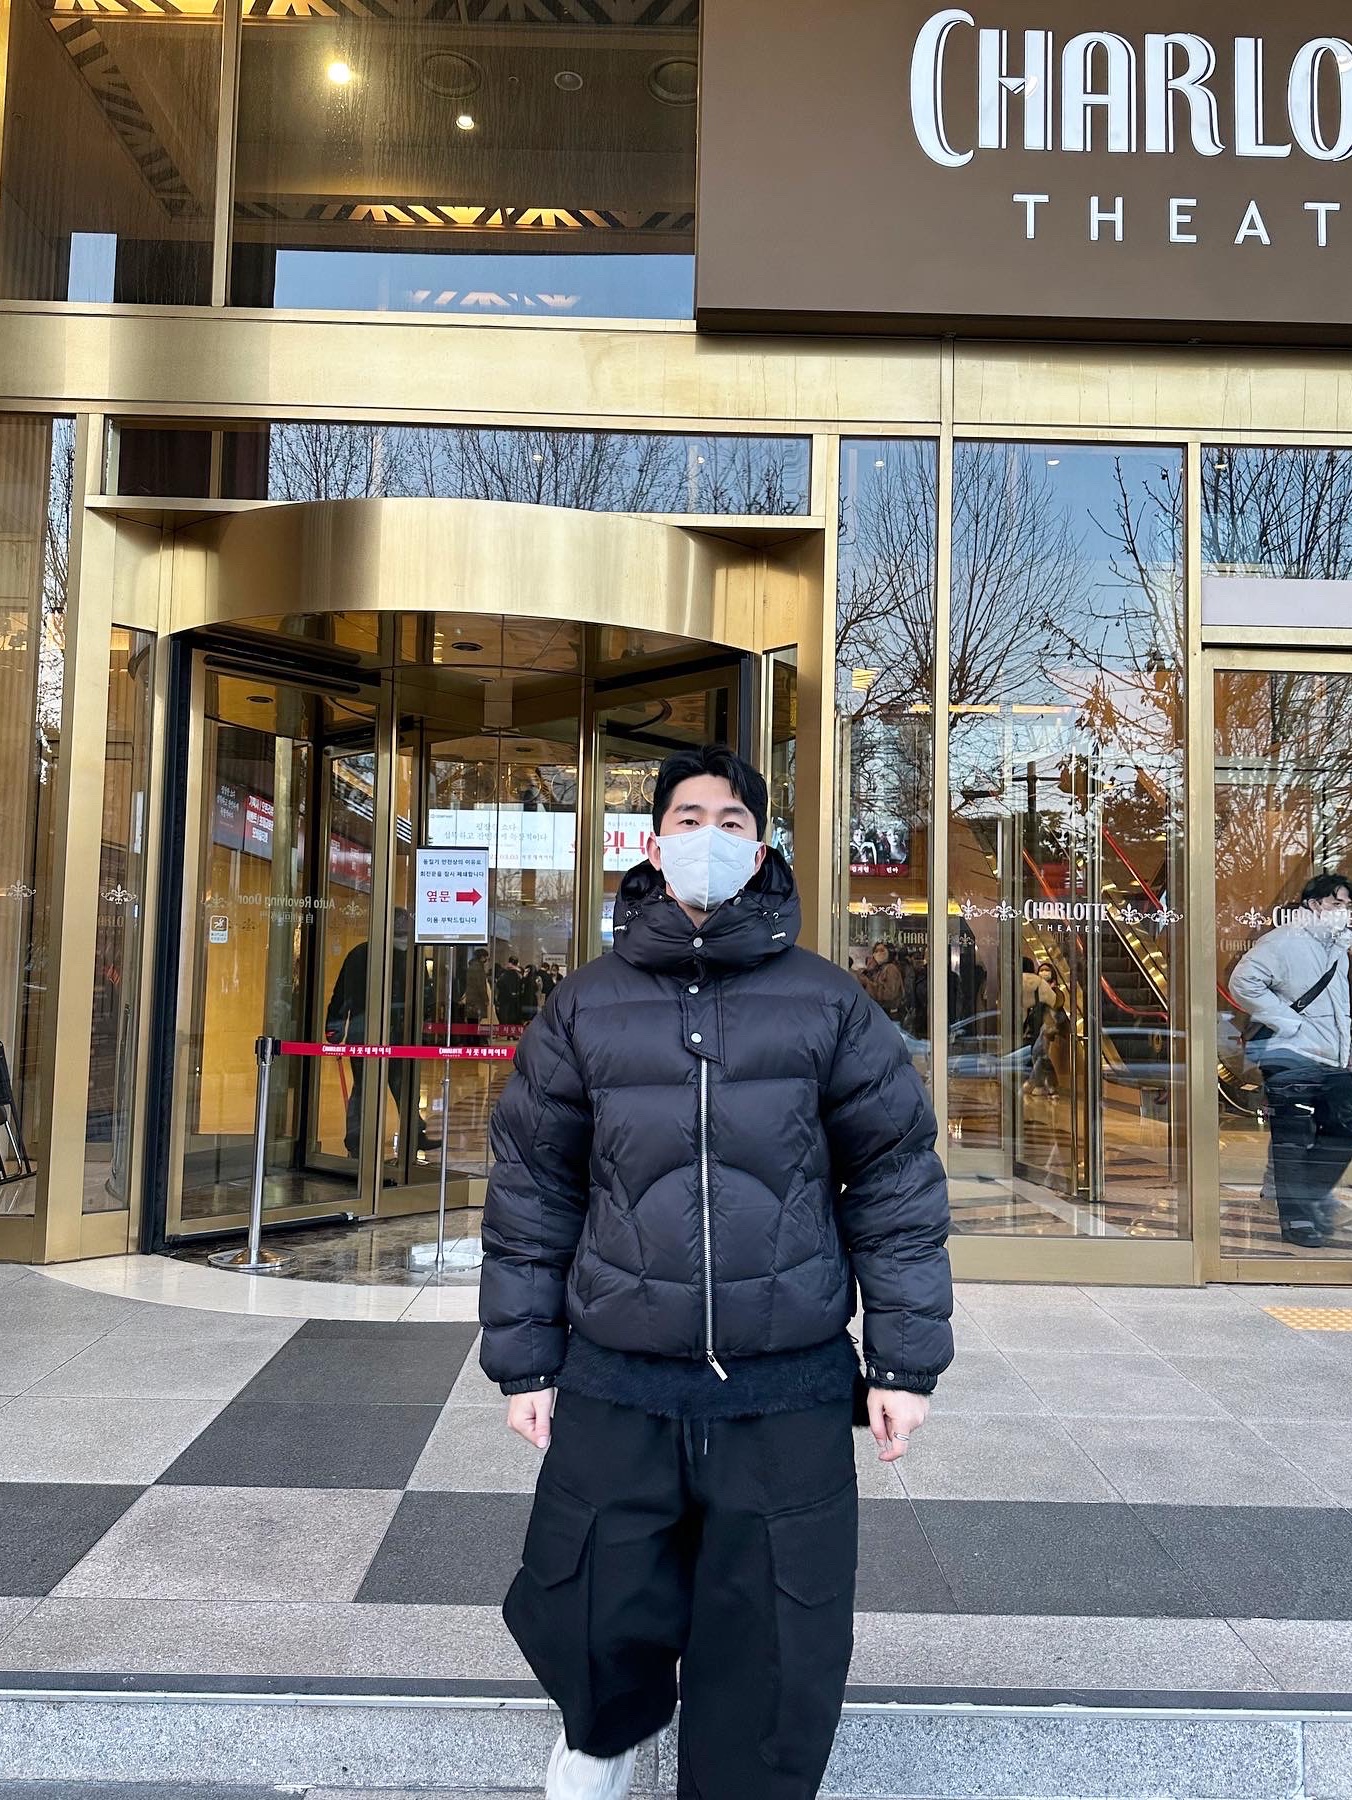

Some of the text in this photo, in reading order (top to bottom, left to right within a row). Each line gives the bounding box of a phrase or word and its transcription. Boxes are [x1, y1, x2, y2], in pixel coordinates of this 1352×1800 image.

[910, 8, 1352, 168] CHARLO
[1012, 193, 1341, 247] THEAT
[426, 890, 451, 903] 옆문
[1024, 899, 1109, 921] CHARLOTTE
[426, 916, 477, 924] 이용 부탁드립니다
[1037, 924, 1100, 933] THEATER
[349, 1046, 392, 1055] 샤롯데씨어터
[465, 1048, 507, 1057] 샤롯데씨어터
